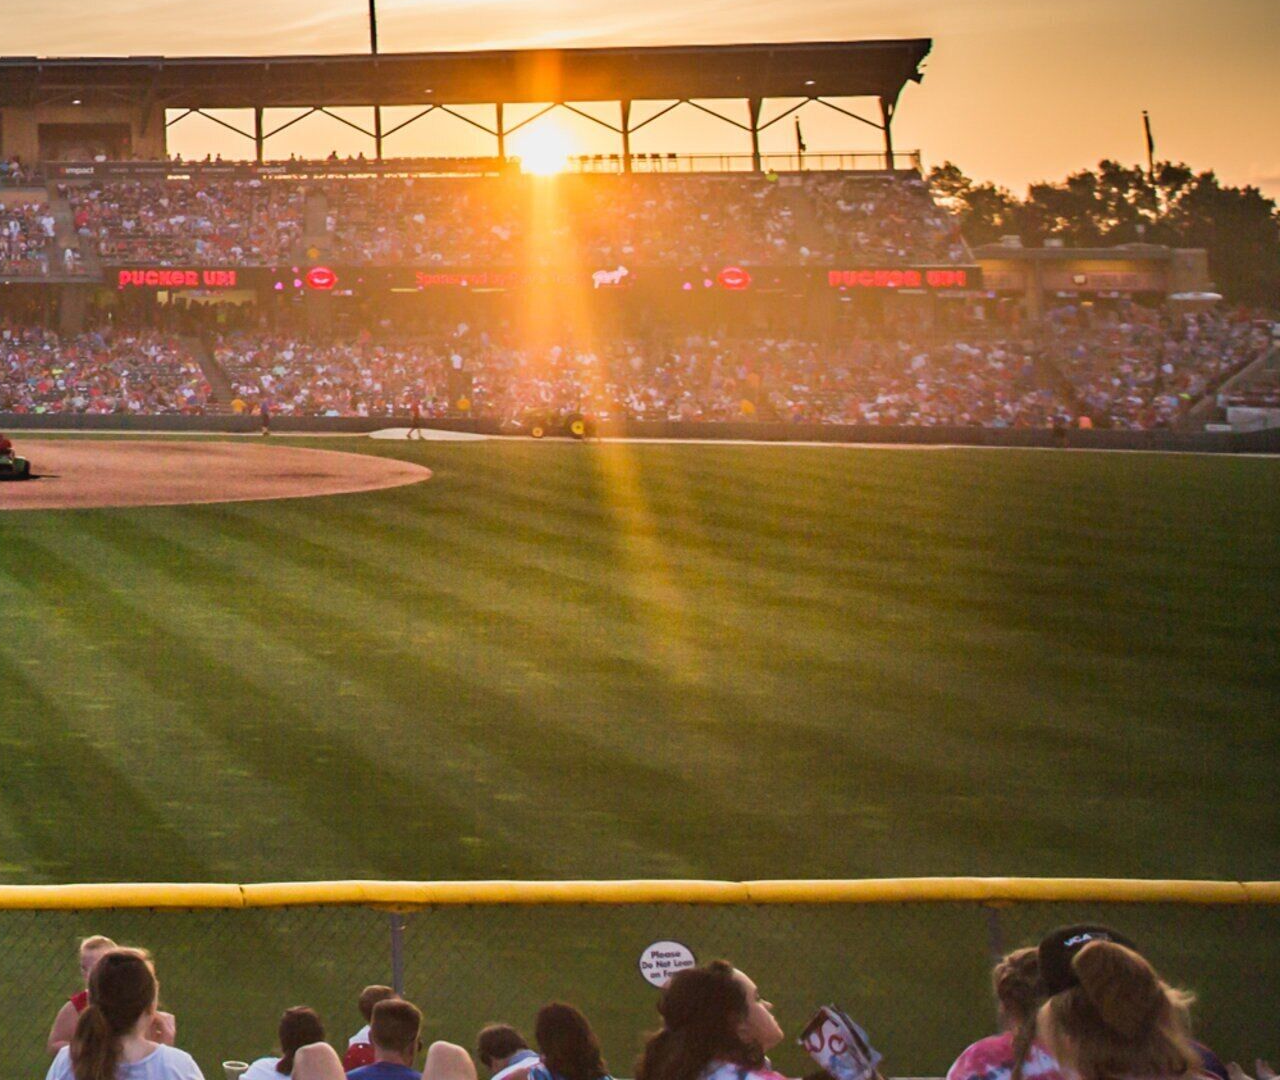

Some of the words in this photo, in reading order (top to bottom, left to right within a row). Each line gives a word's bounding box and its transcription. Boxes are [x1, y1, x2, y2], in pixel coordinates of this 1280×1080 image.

[202, 270, 237, 287] UP!
[926, 270, 967, 287] UP!
[651, 951, 681, 959] Please
[641, 961, 653, 969] Do
[656, 960, 671, 968] Not
[673, 959, 693, 967] Lean
